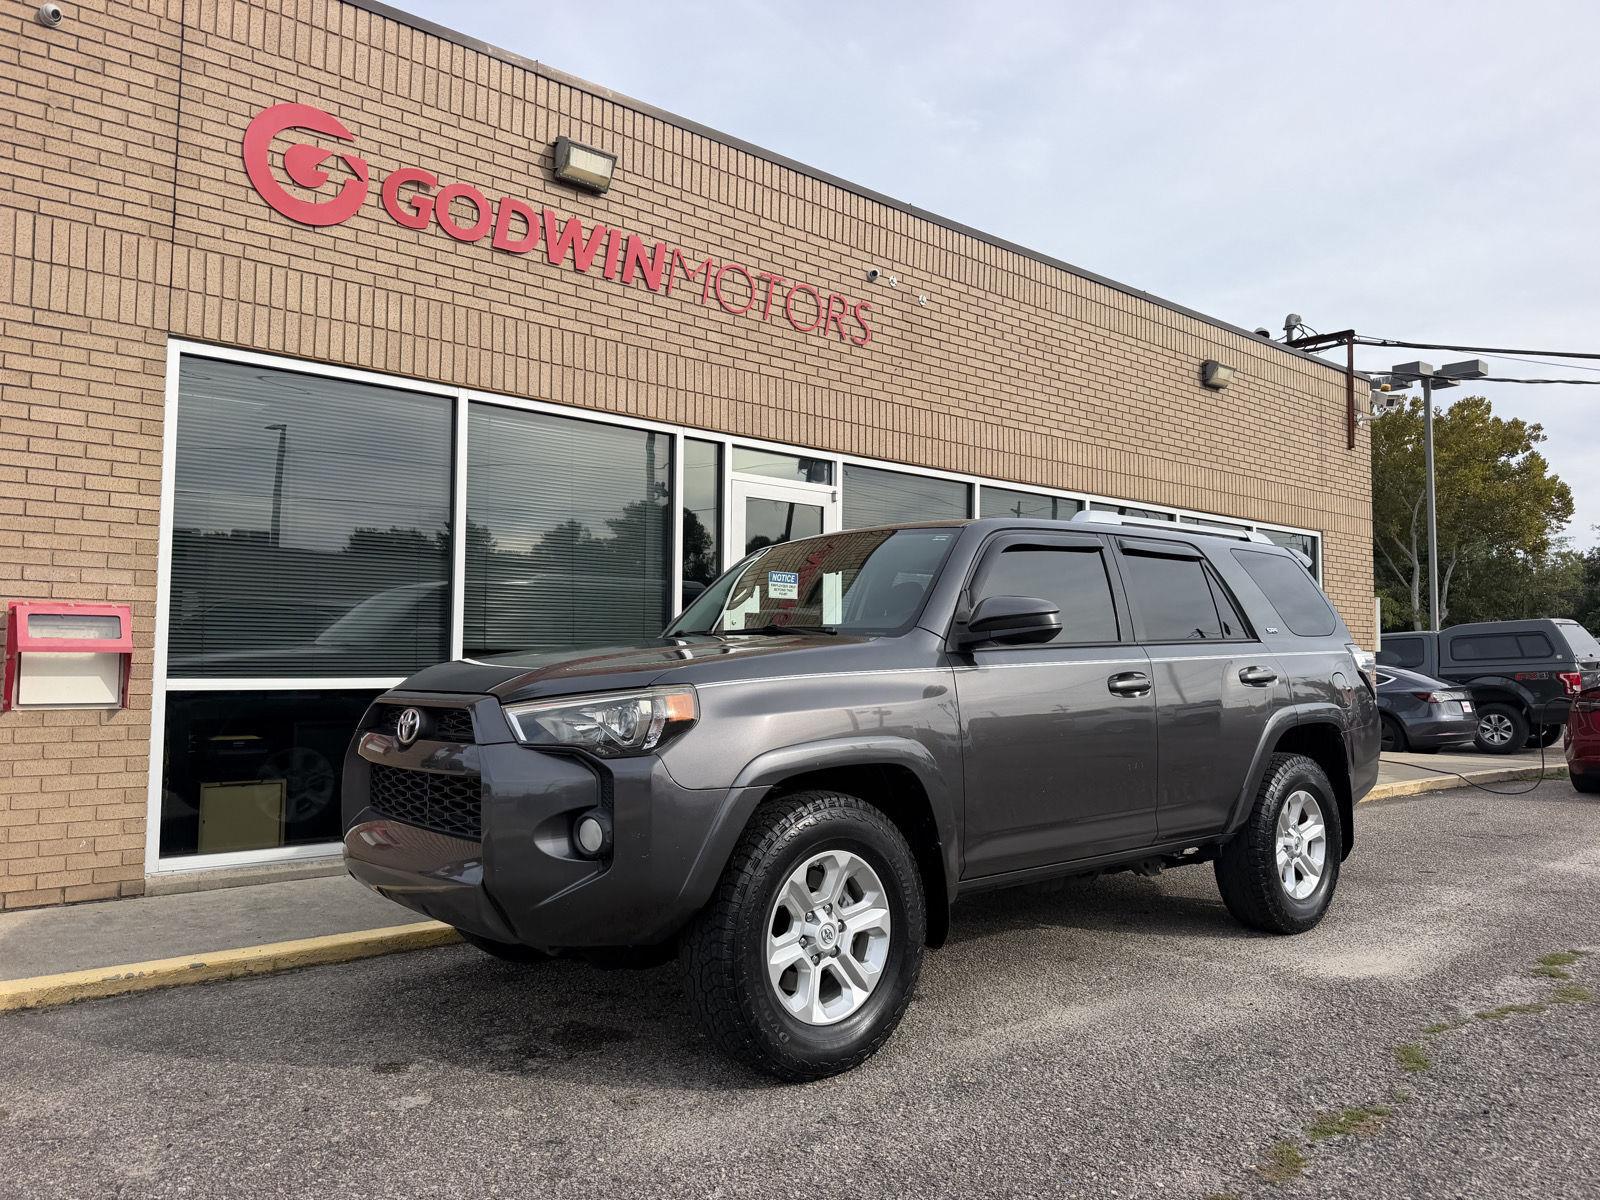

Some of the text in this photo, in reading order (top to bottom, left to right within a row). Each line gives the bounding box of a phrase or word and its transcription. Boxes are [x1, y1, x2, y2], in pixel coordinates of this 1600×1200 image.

[380, 167, 873, 347] GODWIN MOTORS
[771, 573, 795, 583] NOTICE
